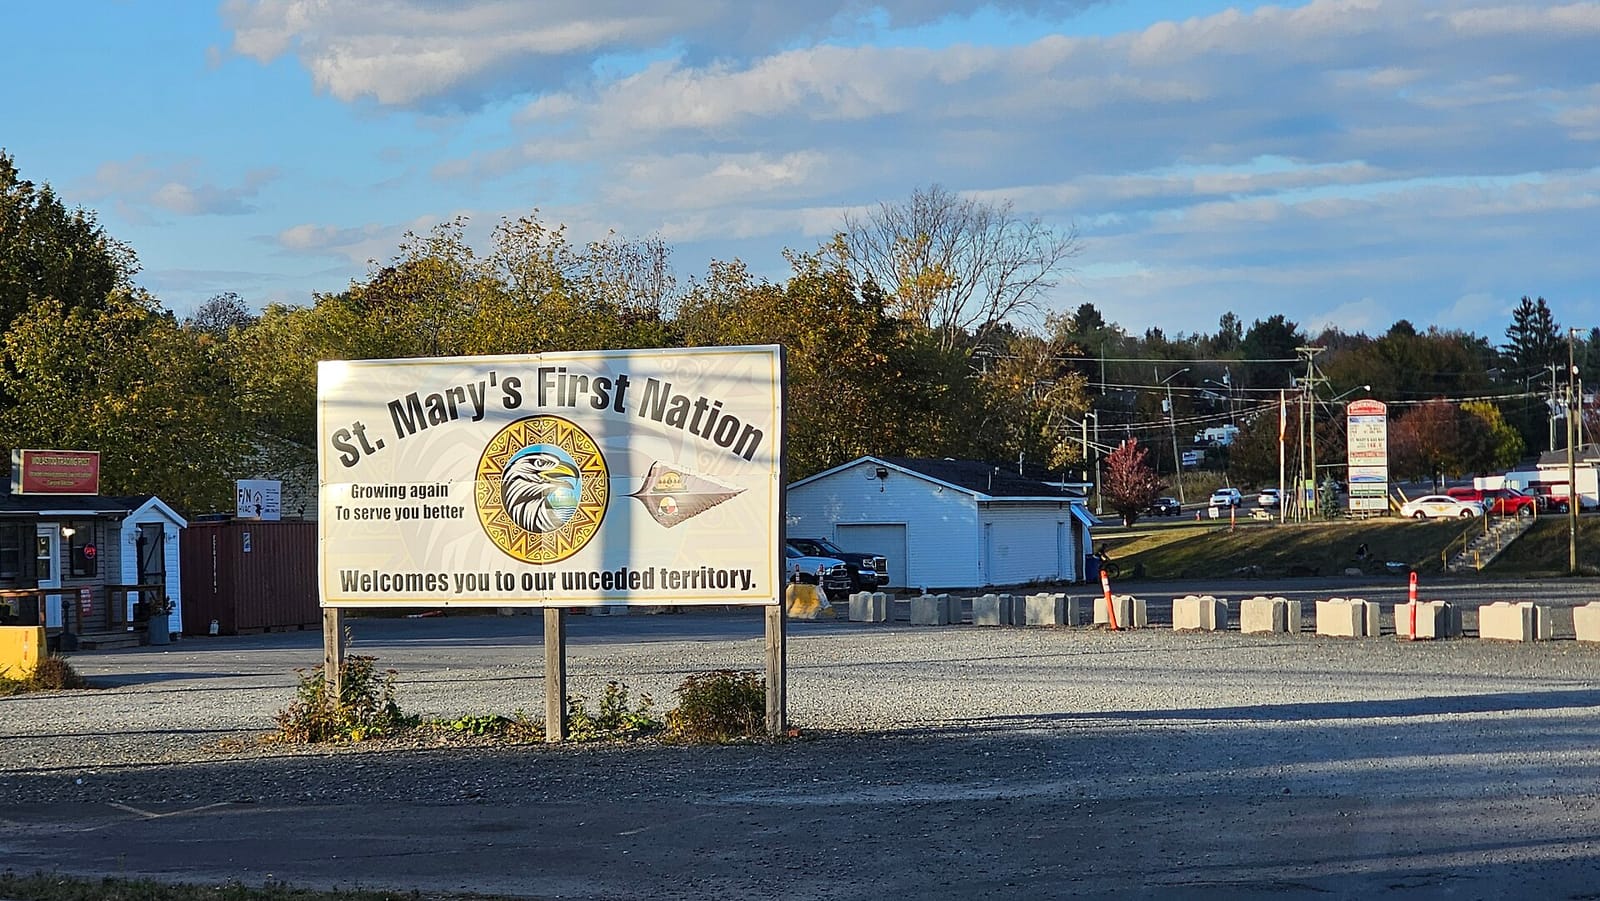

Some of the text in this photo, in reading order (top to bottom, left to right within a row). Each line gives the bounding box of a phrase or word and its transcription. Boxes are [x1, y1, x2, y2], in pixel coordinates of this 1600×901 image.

[331, 366, 764, 468] St. Mary's First Nation
[351, 482, 449, 499] Growing again
[336, 505, 465, 521] To serve you better
[341, 566, 757, 596] Welcomes you to our unceded territory.
